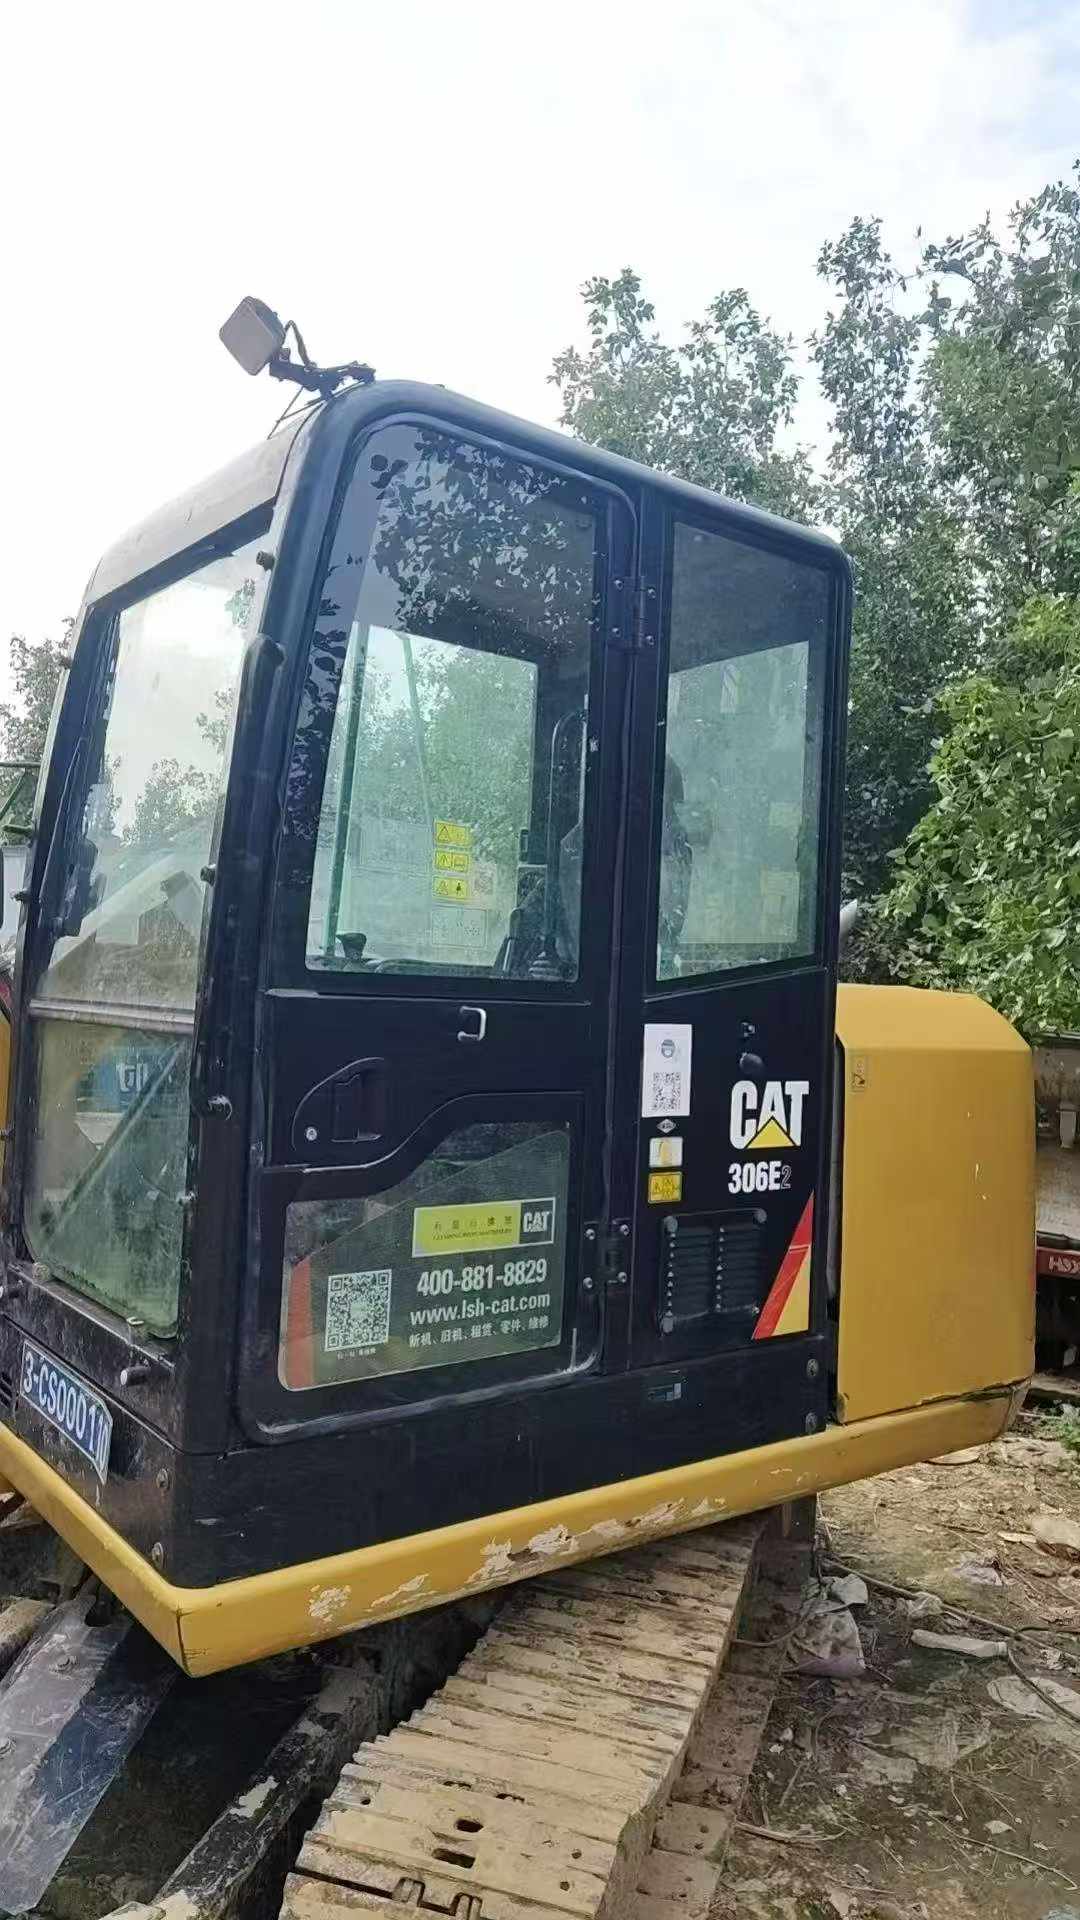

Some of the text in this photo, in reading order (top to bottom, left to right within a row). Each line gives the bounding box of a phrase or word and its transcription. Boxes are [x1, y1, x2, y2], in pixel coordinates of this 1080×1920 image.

[730, 1080, 809, 1149] CAT
[728, 1161, 792, 1194] 306E2
[523, 1211, 552, 1233] CAT
[416, 1258, 548, 1297] 400-881-8829
[410, 1294, 551, 1326] www.lsh-cat.com
